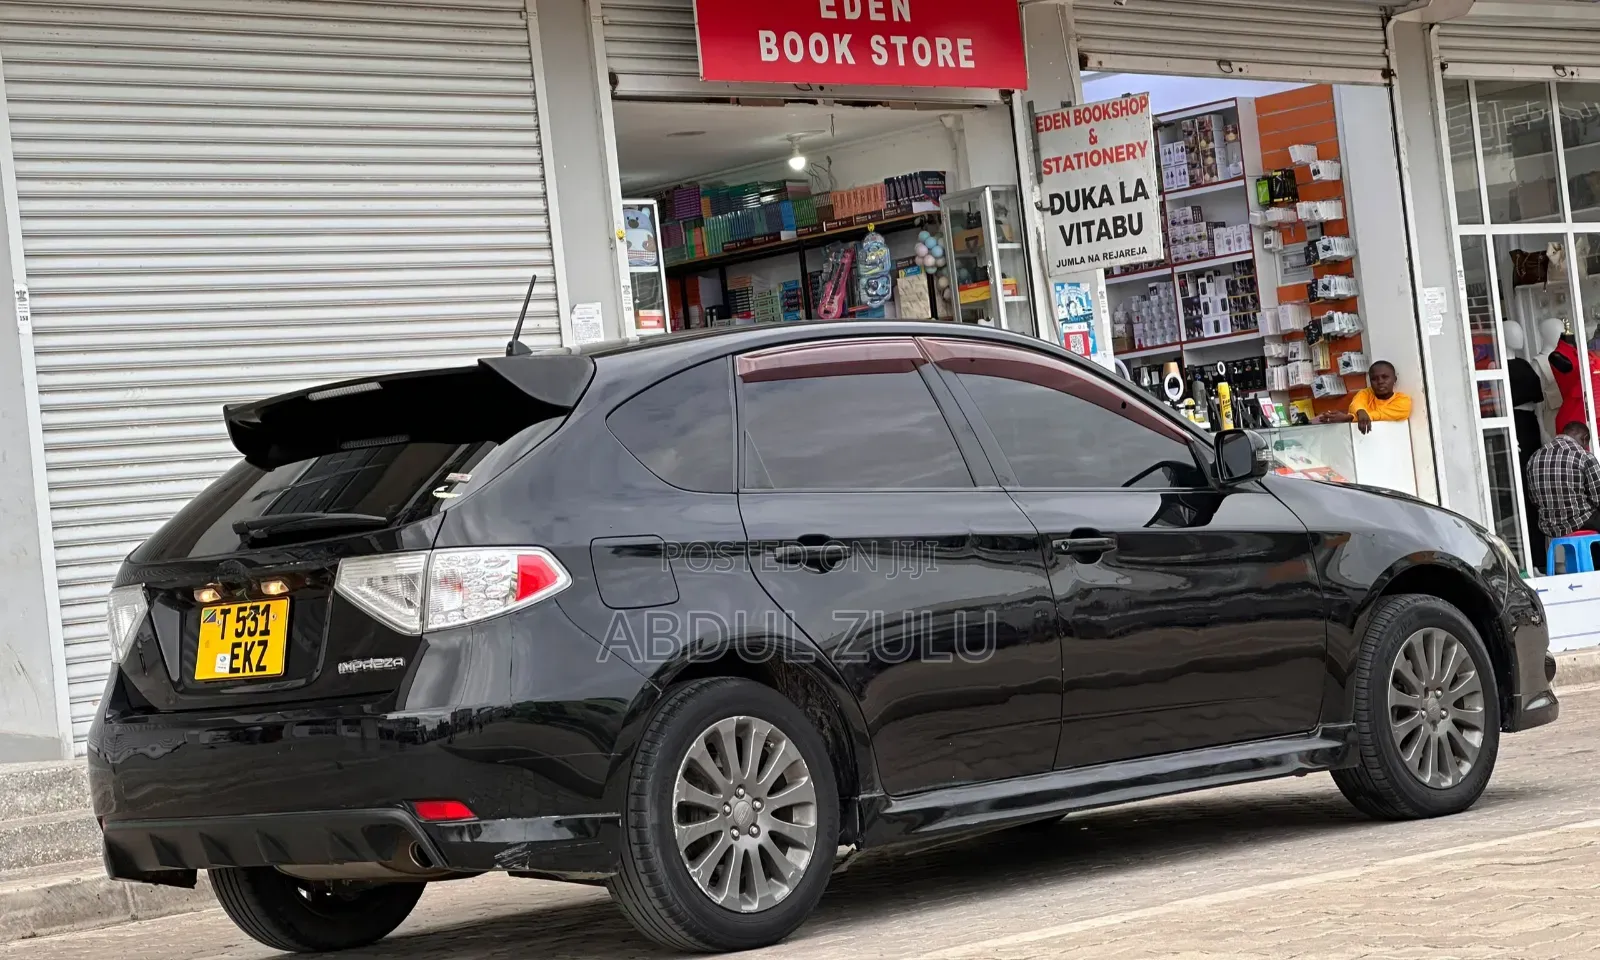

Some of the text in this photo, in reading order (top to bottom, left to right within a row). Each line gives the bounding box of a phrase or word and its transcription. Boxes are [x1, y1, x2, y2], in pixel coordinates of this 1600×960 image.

[820, 0, 911, 22] EDEN
[758, 30, 975, 68] BOOK STORE
[1036, 95, 1149, 133] EDEN BOOKSHOP
[1088, 128, 1098, 145] &
[1042, 140, 1148, 175] STATIONERY
[1049, 178, 1150, 216] DUKA LA
[1059, 212, 1143, 247] VITABU
[1056, 246, 1148, 268] JUMLA NA REJAREJA
[220, 604, 271, 640] T 531
[228, 640, 269, 674] EKZ
[338, 657, 406, 674] IMPREZA
